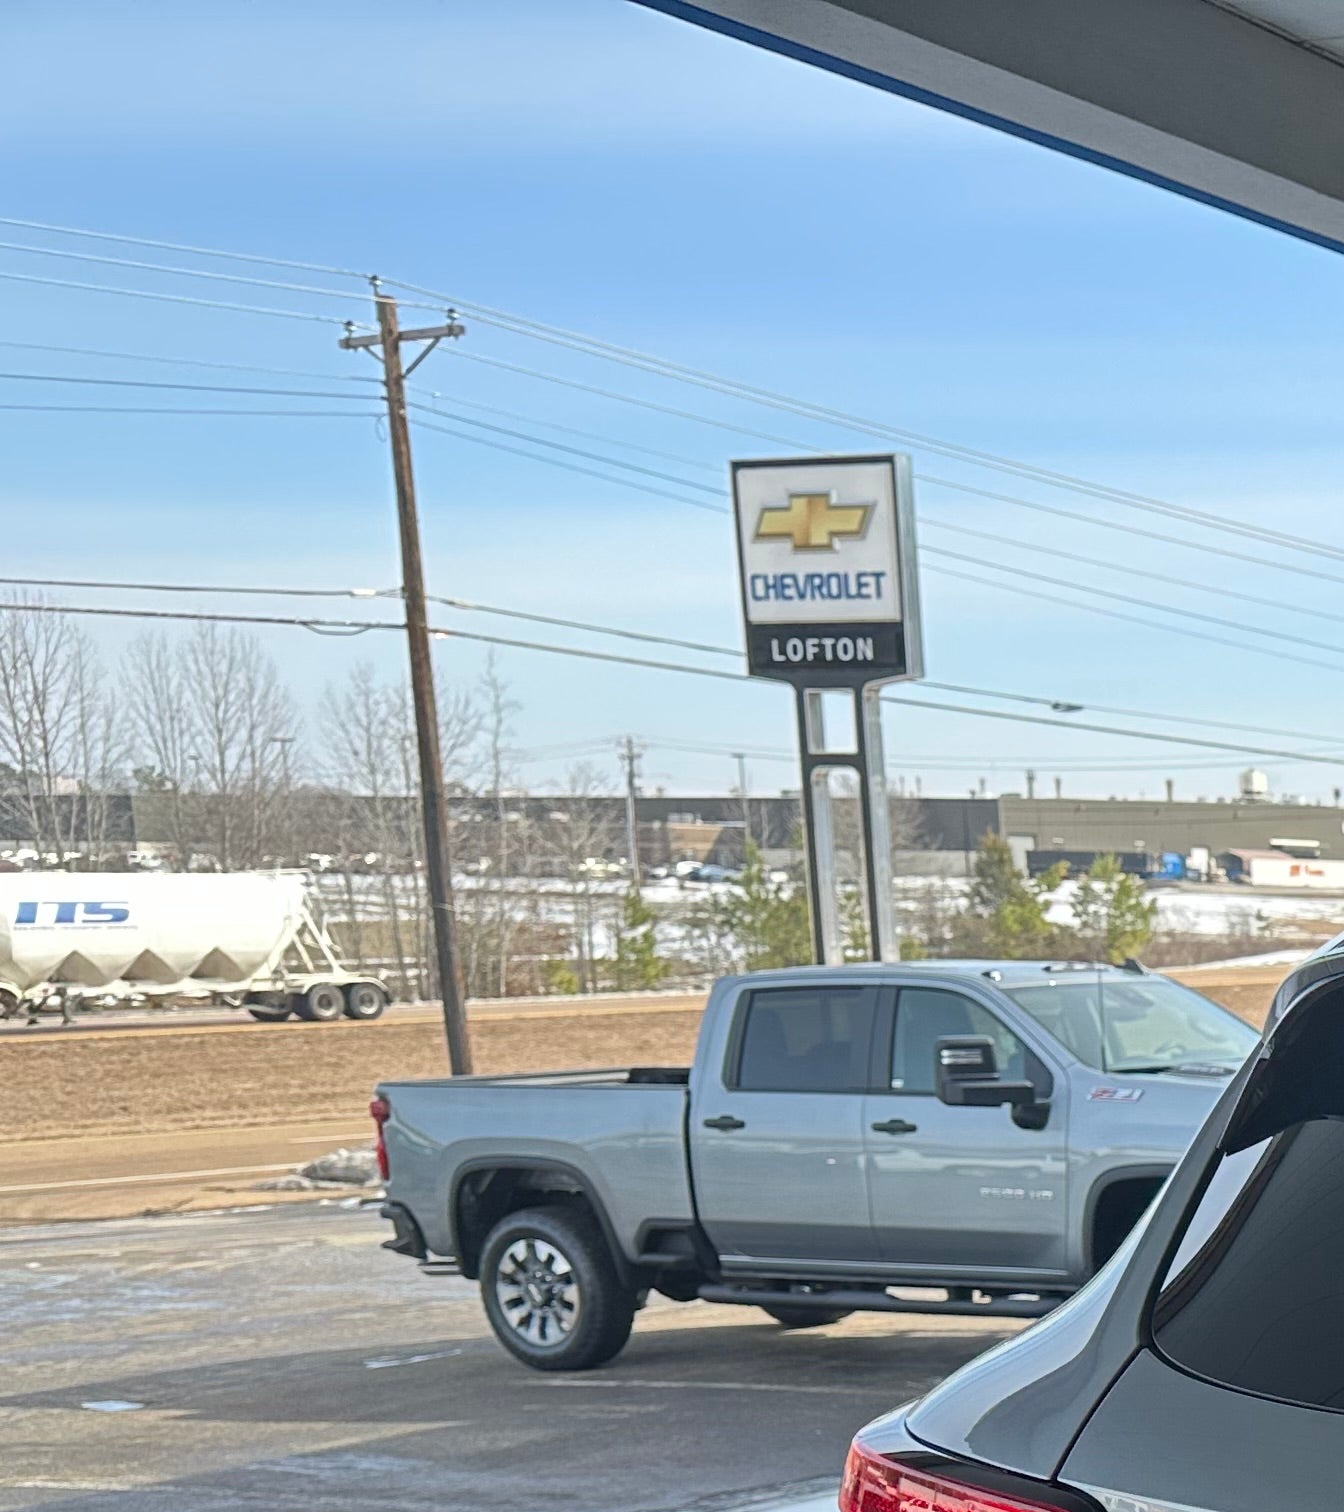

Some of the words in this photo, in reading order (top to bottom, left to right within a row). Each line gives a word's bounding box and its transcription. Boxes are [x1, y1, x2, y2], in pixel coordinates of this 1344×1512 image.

[750, 570, 886, 601] CHEVROLET
[771, 637, 874, 662] LOFTON
[15, 901, 130, 924] ITS
